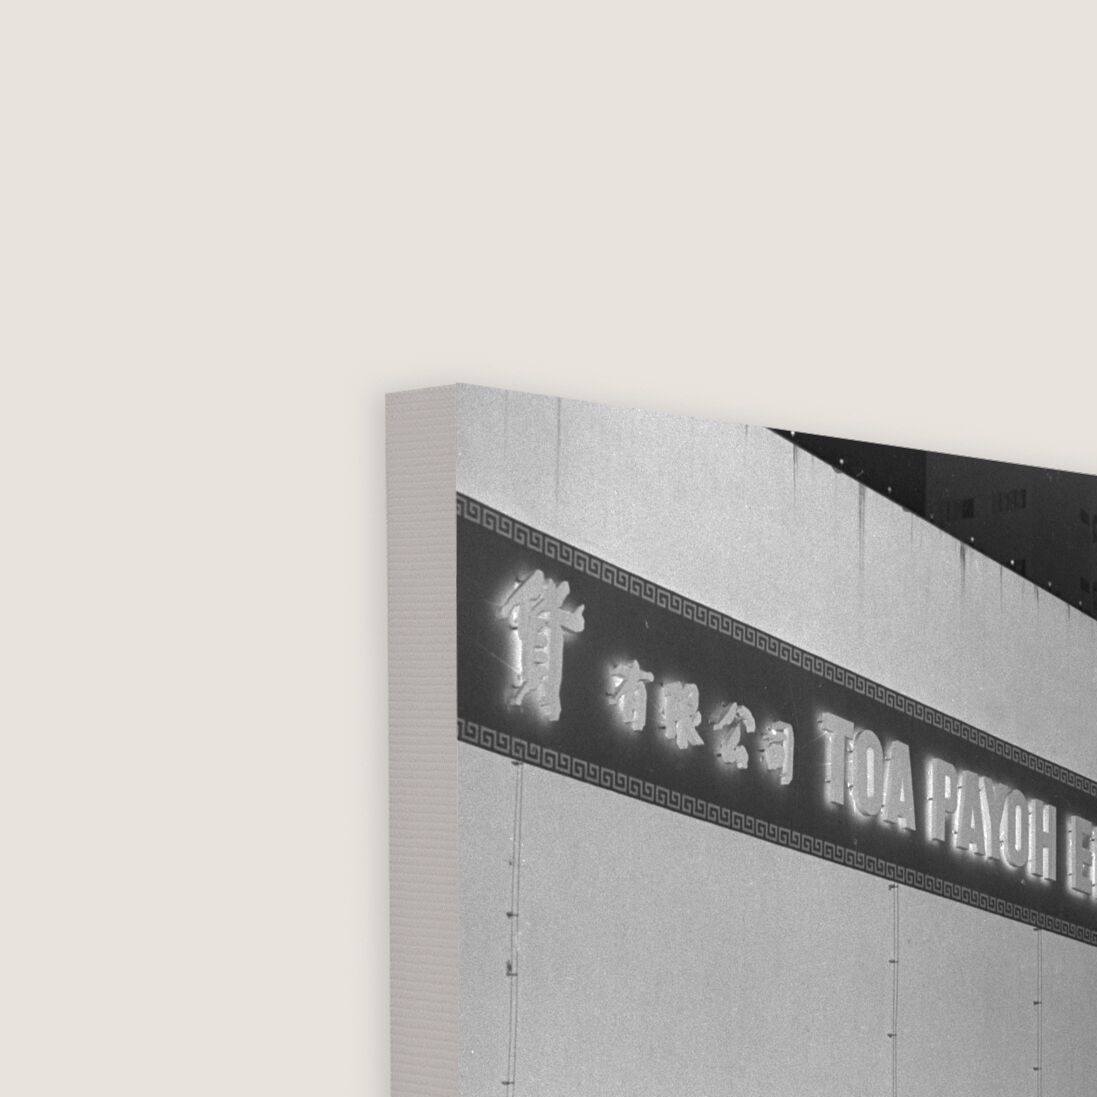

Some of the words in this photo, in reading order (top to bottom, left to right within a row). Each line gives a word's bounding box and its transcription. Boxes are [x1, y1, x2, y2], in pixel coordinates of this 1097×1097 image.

[606, 659, 796, 786] 有限公司
[817, 712, 917, 832] TOA
[925, 757, 1058, 882] PAYOH
